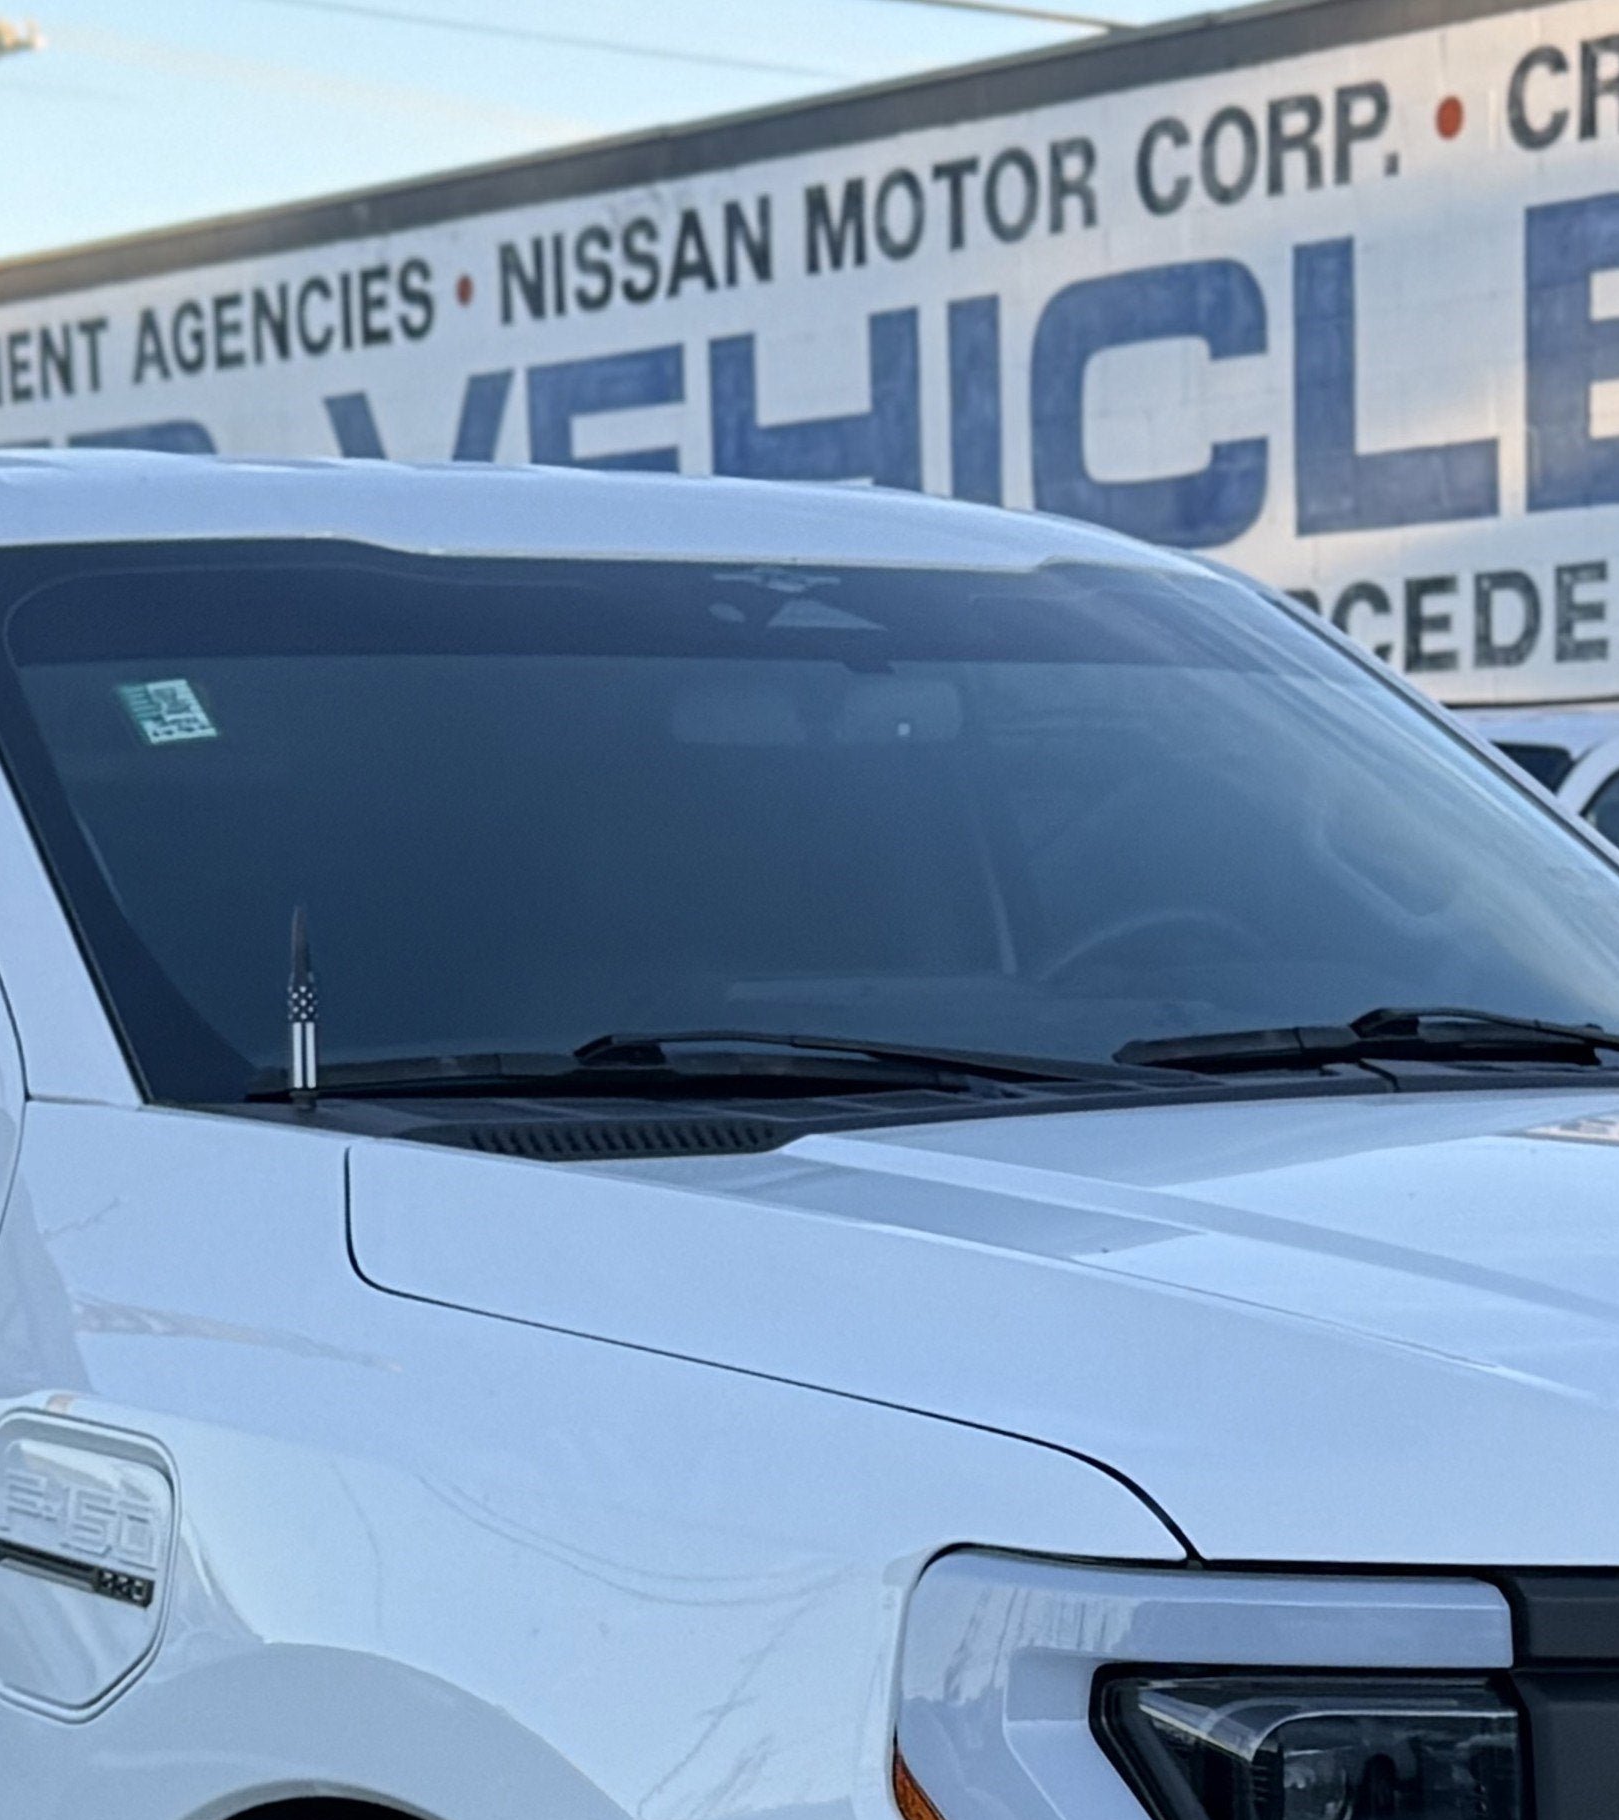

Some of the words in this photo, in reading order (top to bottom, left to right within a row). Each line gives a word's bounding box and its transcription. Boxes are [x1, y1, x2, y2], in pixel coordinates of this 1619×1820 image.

[134, 256, 436, 385] AGENCIES
[499, 193, 775, 326] NISSAN
[804, 136, 1100, 276] MOTOR
[1135, 80, 1401, 217] CORP.
